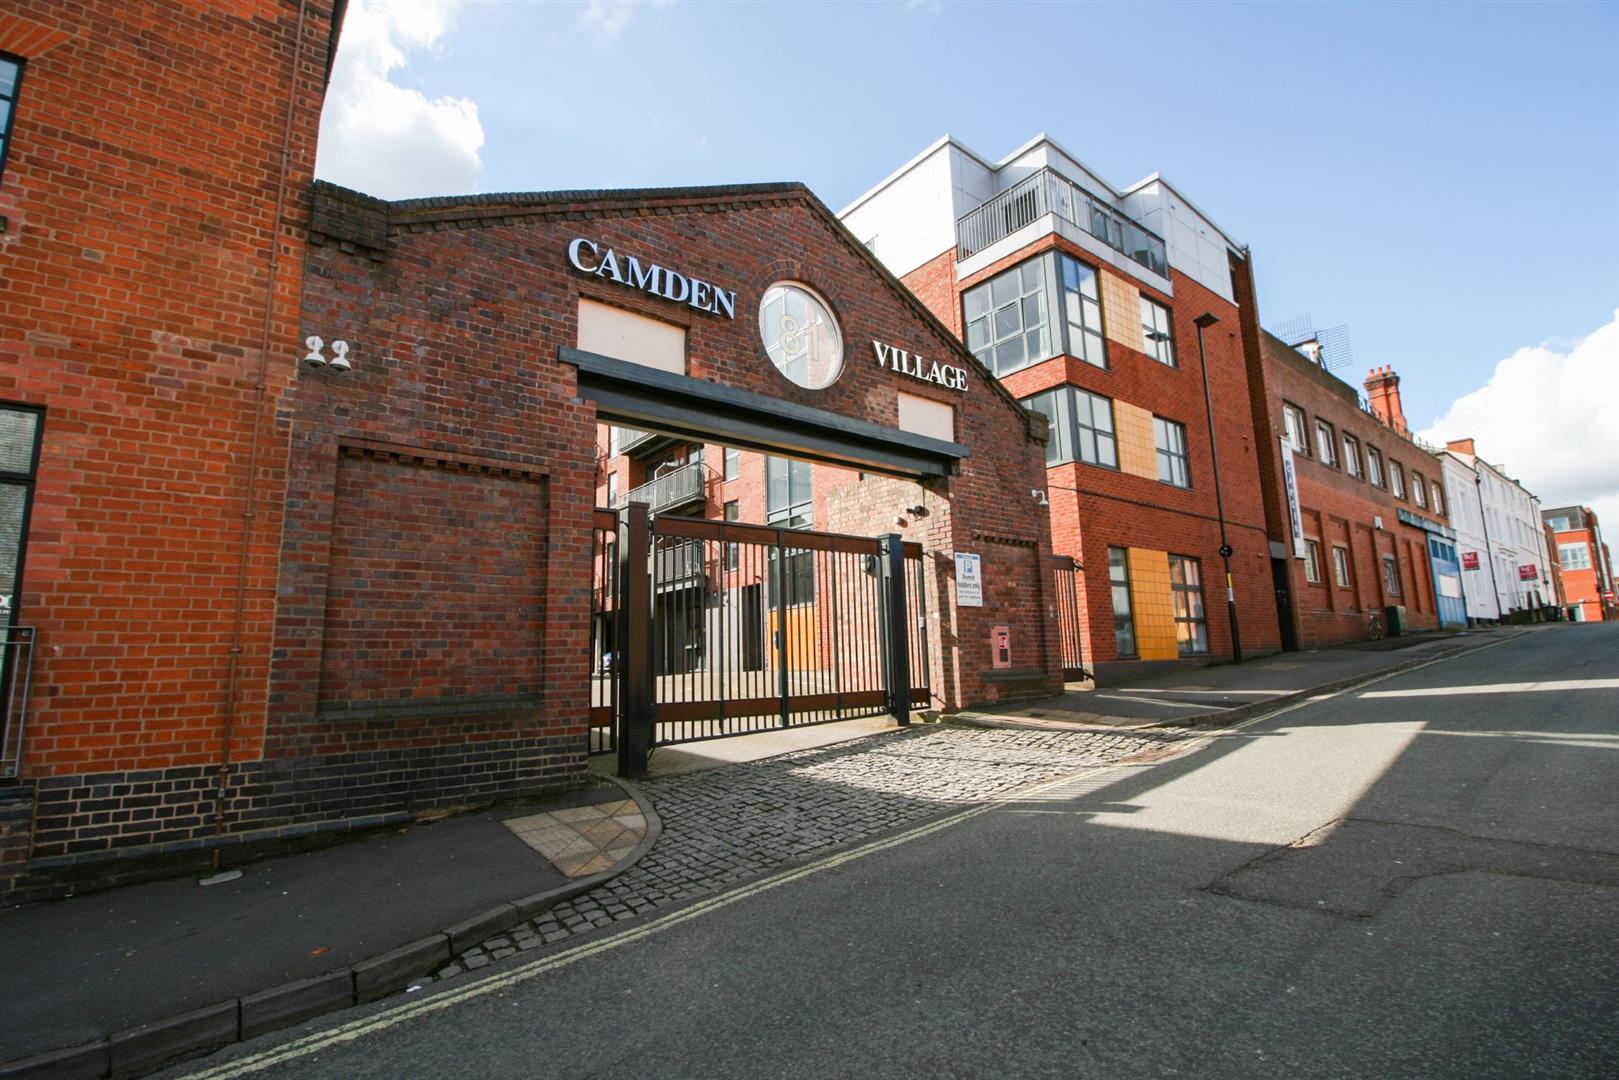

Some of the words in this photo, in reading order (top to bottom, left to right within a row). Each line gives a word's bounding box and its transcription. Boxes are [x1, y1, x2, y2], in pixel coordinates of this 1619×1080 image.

[568, 238, 737, 320] CAMDEN
[872, 340, 969, 392] VILLAGE
[779, 314, 820, 362] 81
